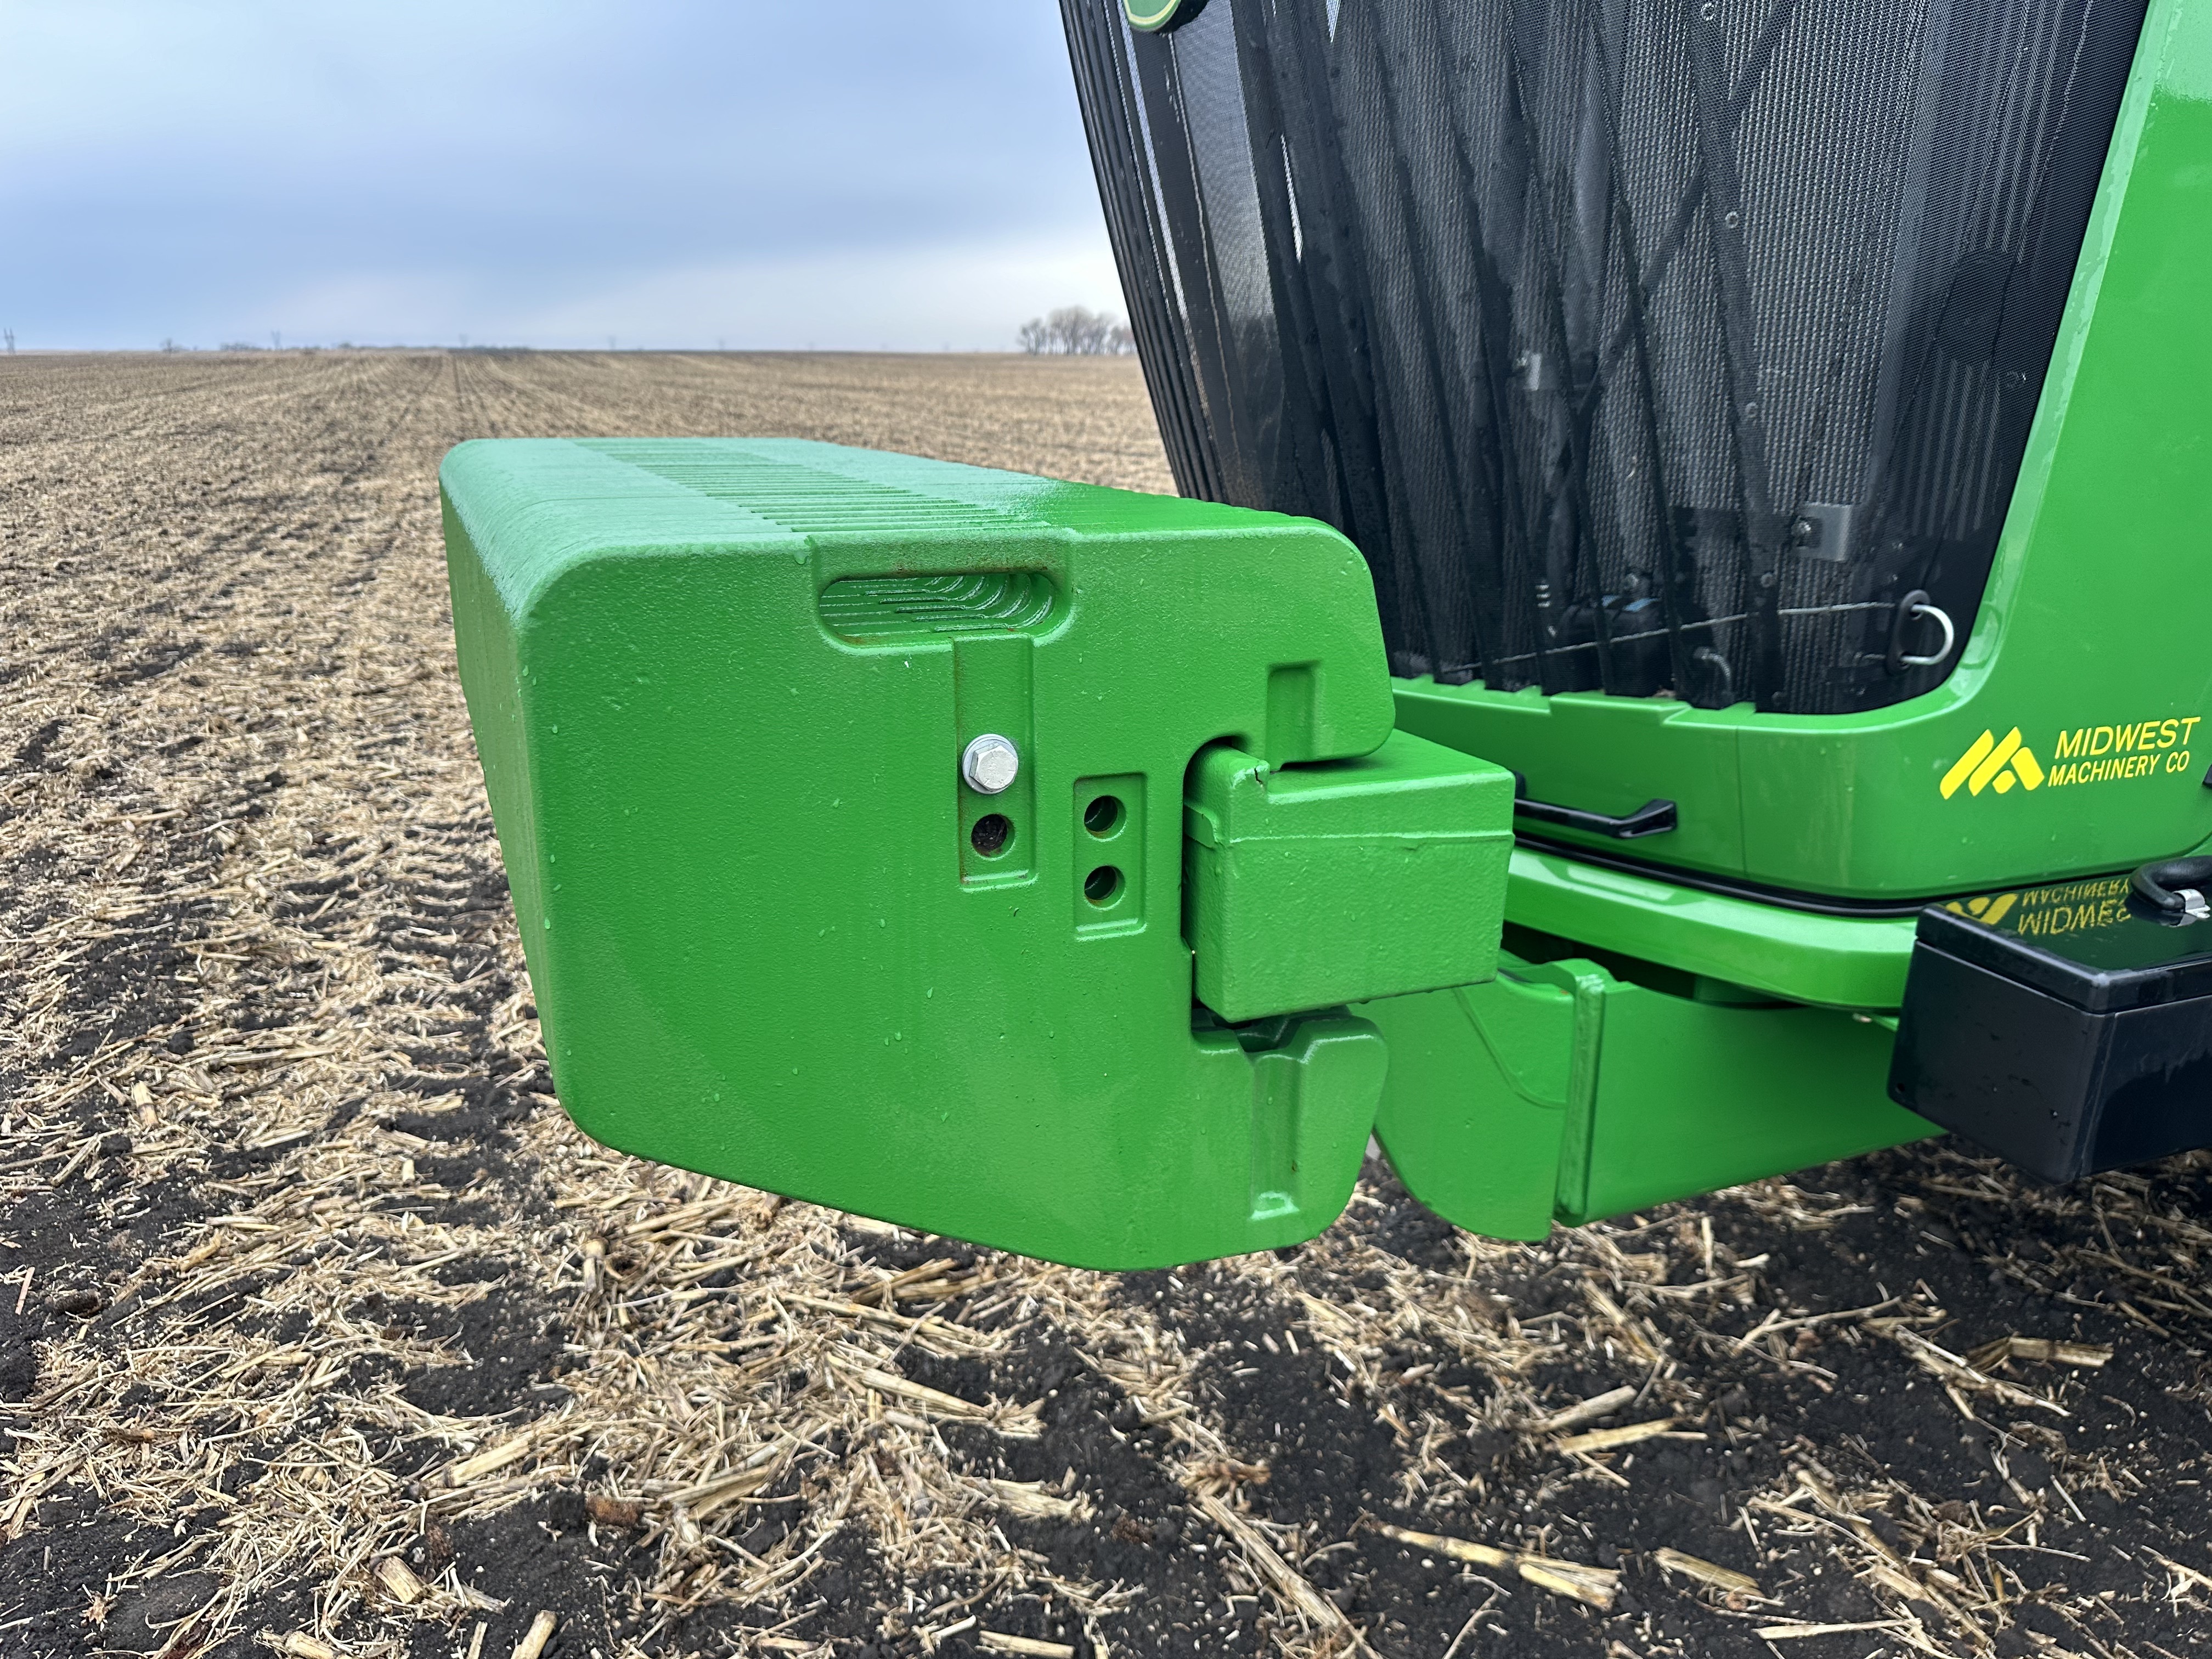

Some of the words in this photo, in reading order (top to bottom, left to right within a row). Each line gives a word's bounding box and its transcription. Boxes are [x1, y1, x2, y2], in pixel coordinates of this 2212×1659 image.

[2055, 716, 2201, 759] MIDWEST
[2047, 755, 2161, 787] MACHINERY
[2165, 751, 2190, 772] CO
